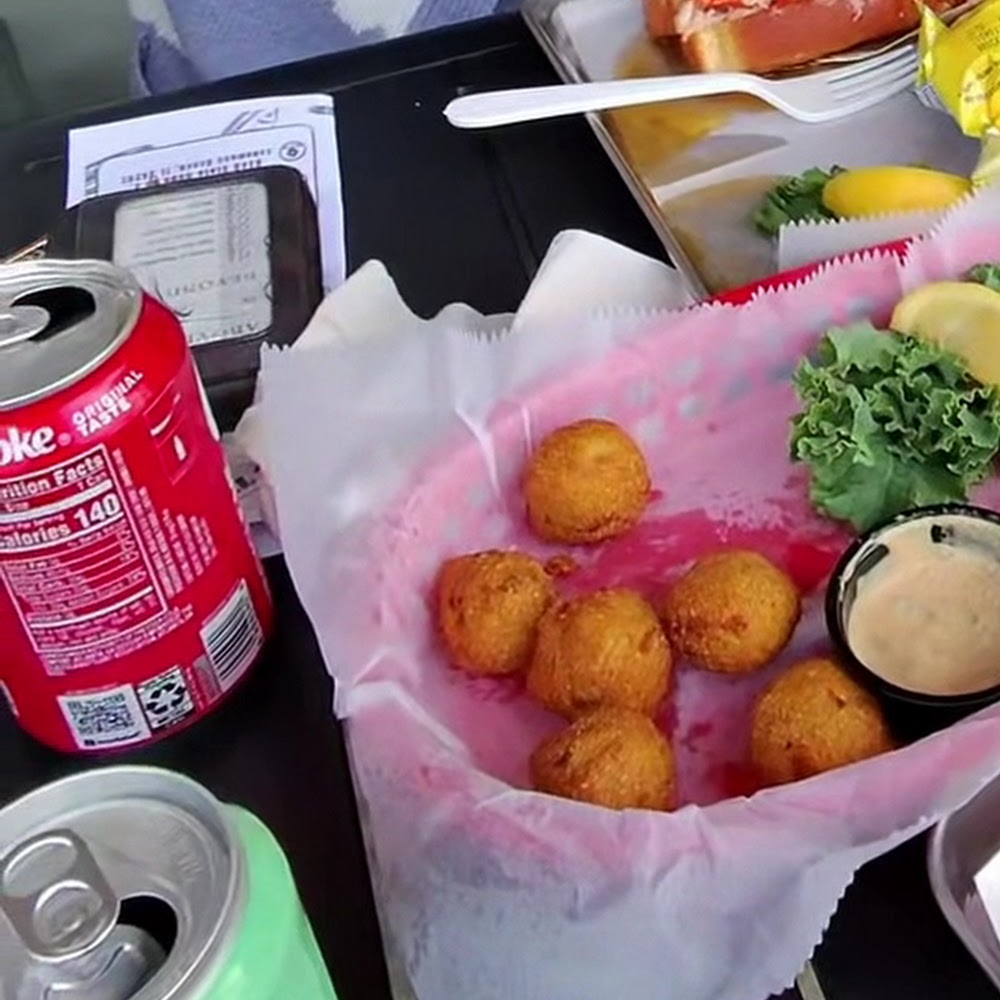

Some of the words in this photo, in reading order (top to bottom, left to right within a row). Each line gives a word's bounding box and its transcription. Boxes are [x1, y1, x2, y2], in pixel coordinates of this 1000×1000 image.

[72, 370, 143, 425] ORIGINAL
[76, 396, 134, 438] TASTE
[53, 454, 104, 486] Facts
[0, 523, 71, 548] alories
[74, 493, 120, 529] 140
